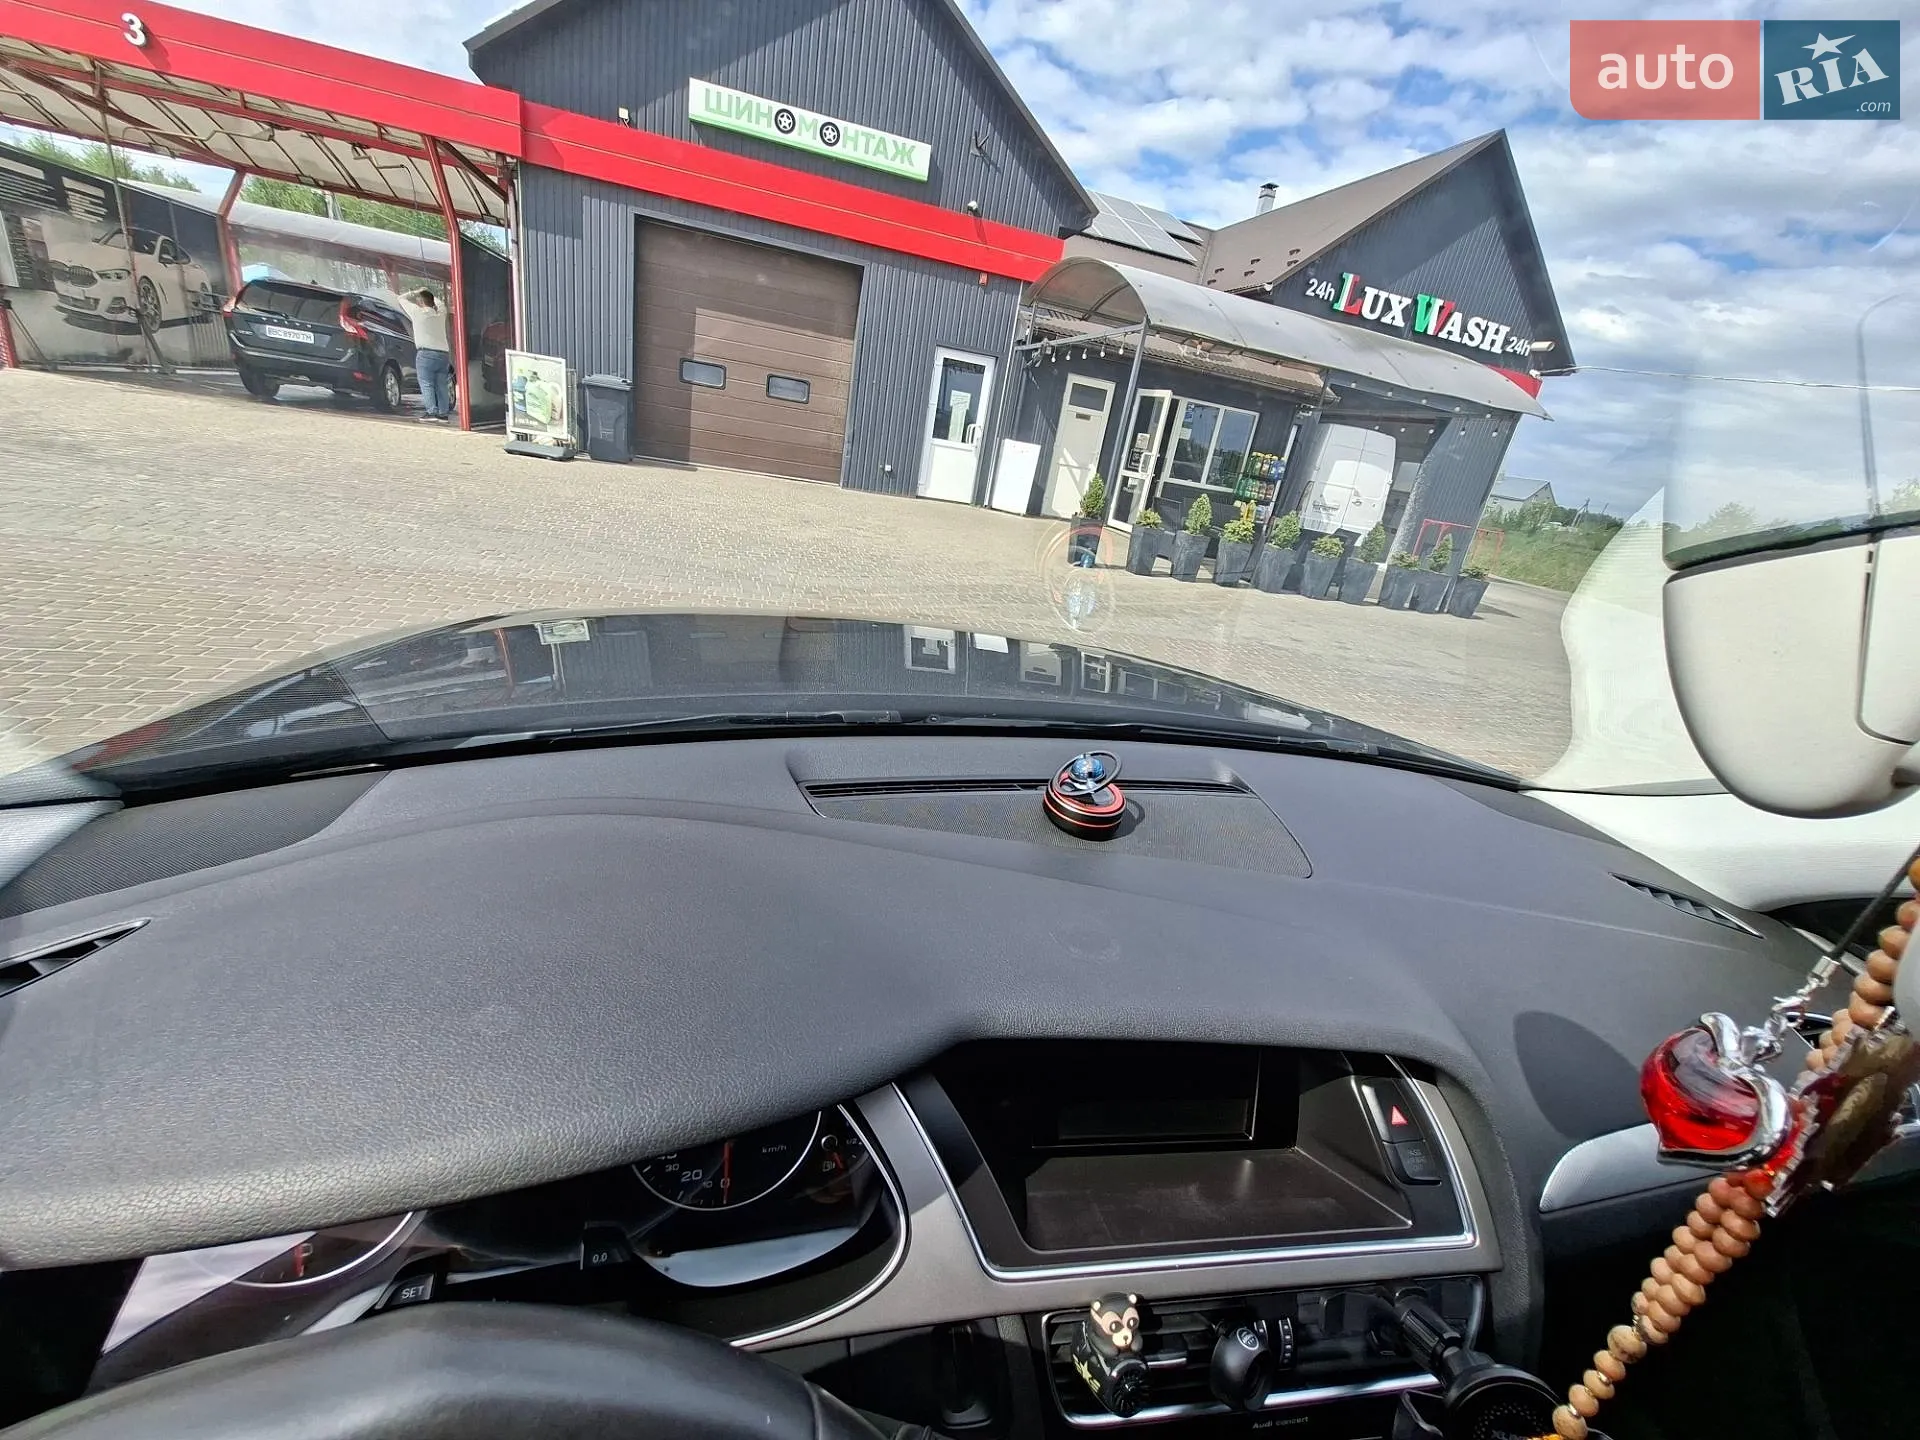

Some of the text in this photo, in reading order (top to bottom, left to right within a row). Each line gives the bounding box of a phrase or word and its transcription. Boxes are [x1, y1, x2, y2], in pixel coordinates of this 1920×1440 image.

[121, 12, 146, 47] 3
[704, 87, 916, 167] ШИНОМОНТАЖ
[1305, 272, 1532, 357] 24h LUX WASH 24h
[665, 1163, 680, 1172] 30
[681, 1169, 703, 1182] 20
[401, 1284, 424, 1299] SET
[1252, 1420, 1273, 1430] Audi
